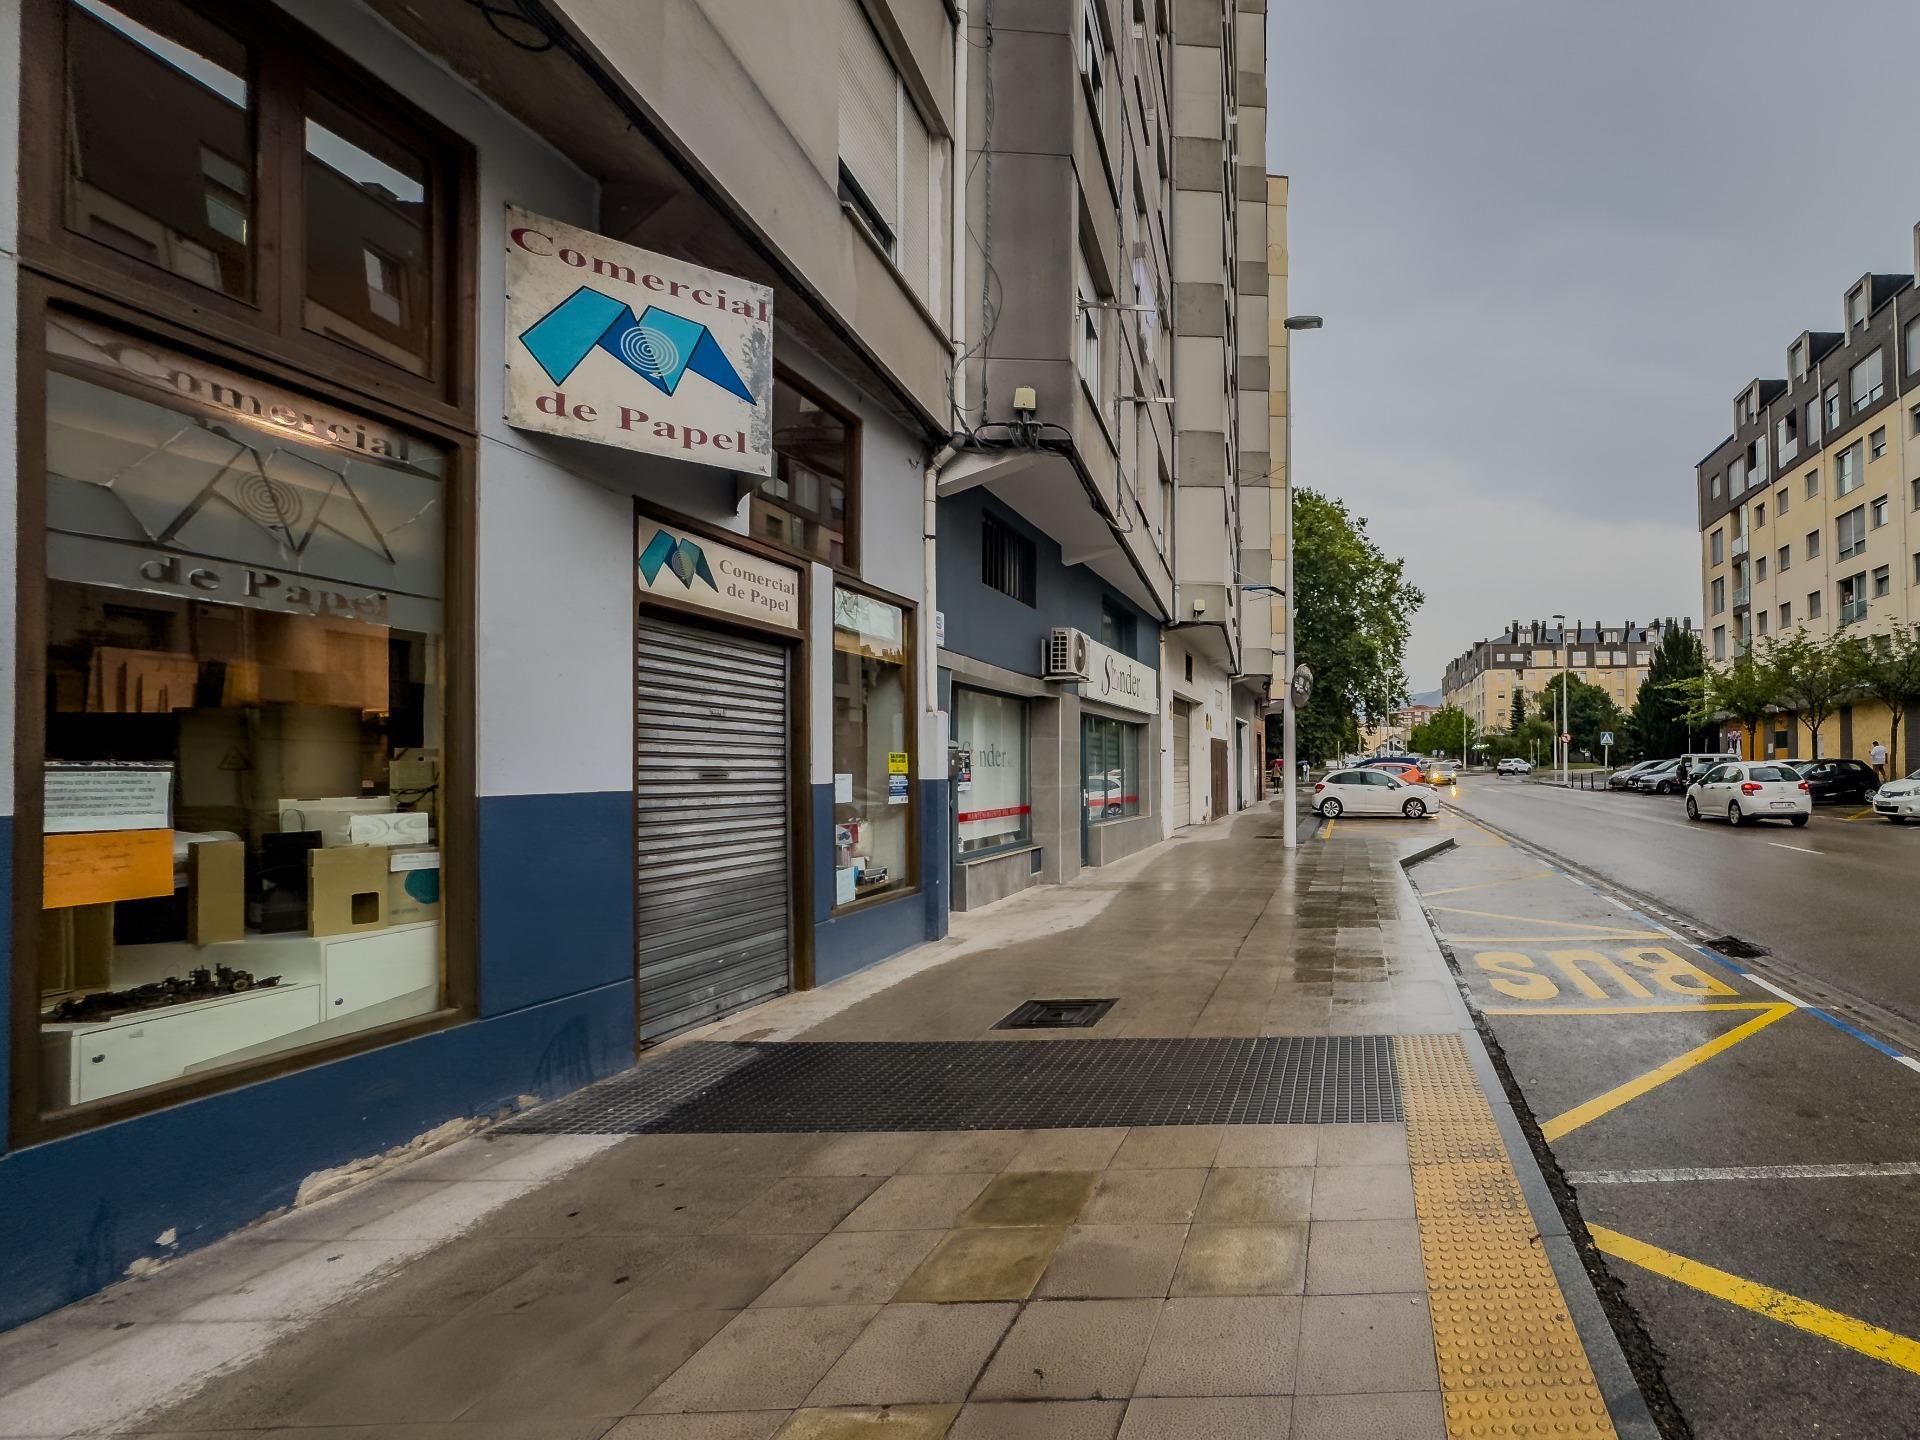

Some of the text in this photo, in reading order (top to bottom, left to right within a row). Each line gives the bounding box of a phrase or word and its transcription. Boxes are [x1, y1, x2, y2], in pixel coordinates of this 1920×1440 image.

[510, 227, 769, 323] Comercial
[103, 342, 410, 463] Comercial
[535, 391, 750, 455] de Papel
[139, 556, 389, 618] de Papel
[719, 559, 795, 596] Comercial
[727, 583, 789, 613] de Papel
[1473, 947, 1740, 1000] BUS
